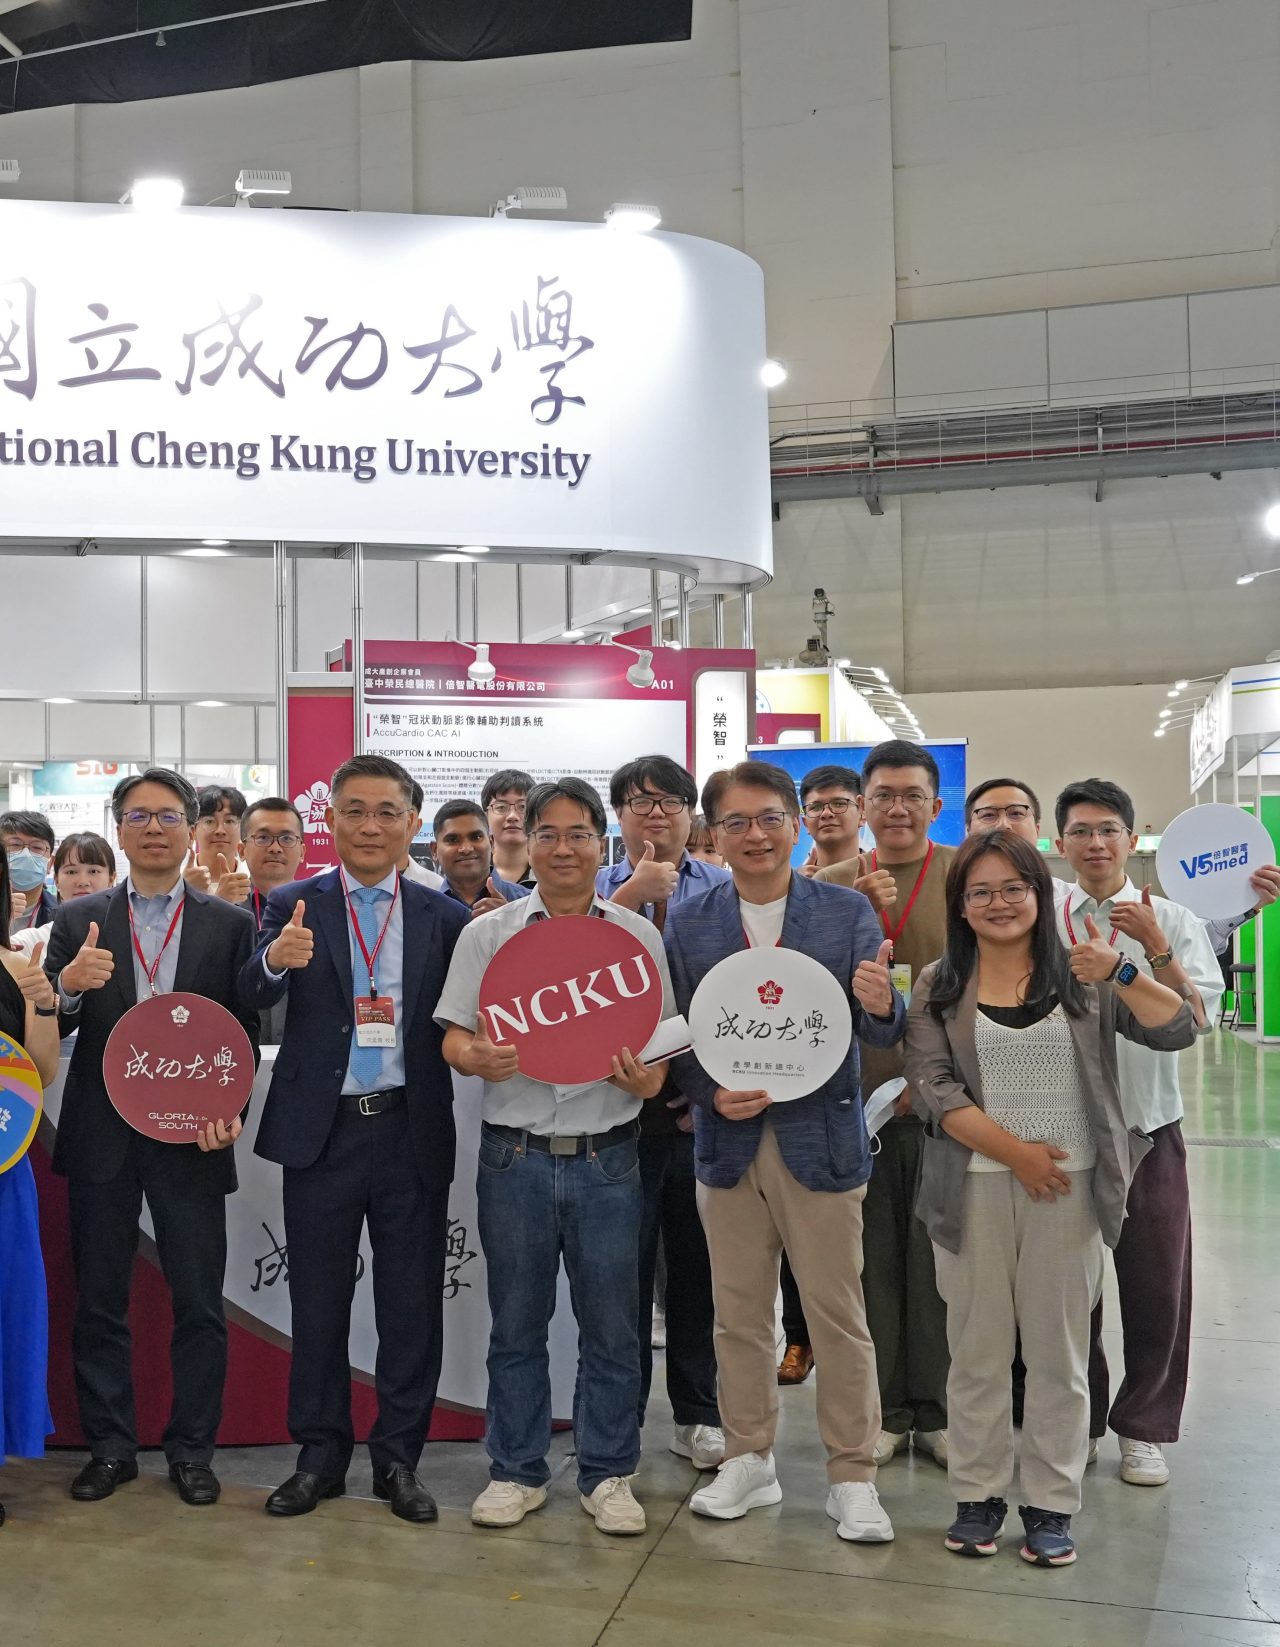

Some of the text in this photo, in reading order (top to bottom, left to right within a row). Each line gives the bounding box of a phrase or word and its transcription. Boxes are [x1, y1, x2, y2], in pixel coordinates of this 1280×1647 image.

[130, 430, 260, 480] Cheng
[270, 434, 377, 484] Kung
[386, 438, 592, 489] University
[651, 680, 674, 690] A01
[373, 728, 461, 738] AccuCardio CAC AI
[366, 749, 424, 758] DESCRIPTION
[1213, 842, 1248, 860] 倍智醫電
[484, 954, 651, 1043] NCKU
[714, 1006, 828, 1048] 成功大學
[124, 1044, 237, 1086] 成功大學
[148, 1112, 195, 1121] GLORIA
[158, 1121, 198, 1130] SOUTH
